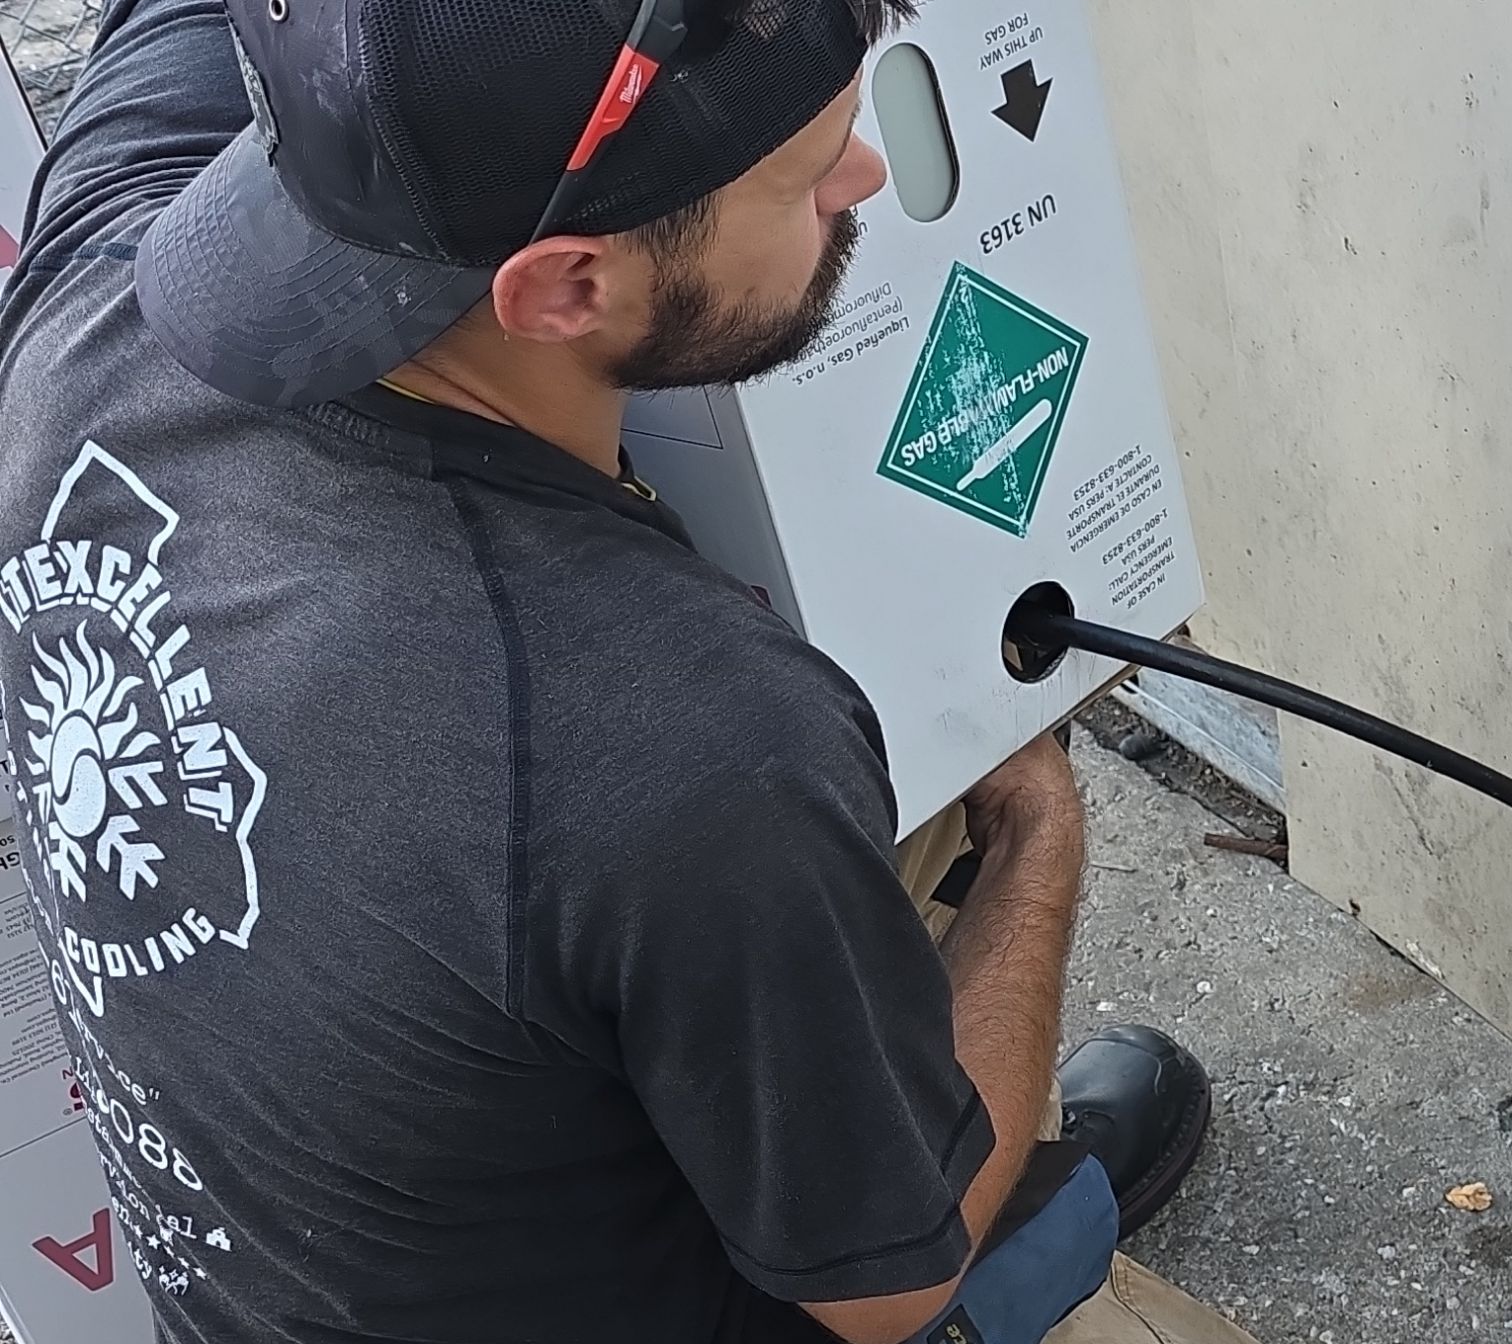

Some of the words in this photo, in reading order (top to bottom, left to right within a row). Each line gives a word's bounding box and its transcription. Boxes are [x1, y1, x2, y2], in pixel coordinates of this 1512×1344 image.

[1008, 13, 1028, 32] FOR
[985, 25, 1006, 45] GAS
[1029, 27, 1043, 42] UP
[1005, 36, 1027, 56] THIS
[981, 49, 1003, 69] WAY
[1028, 195, 1055, 226] UN
[980, 213, 1024, 254] 3163
[856, 317, 909, 355] Liquefied
[828, 348, 853, 365] Gas,
[792, 363, 825, 385] n.o.s.
[896, 429, 940, 467] GAS
[1074, 445, 1140, 500] 1-800-633-8253
[1115, 455, 1151, 487] CONTACTE
[1125, 465, 1159, 496] DURANTE
[1105, 482, 1113, 492] A:
[1152, 479, 1161, 492] EN
[1086, 490, 1104, 509] PERS
[1116, 491, 1125, 502] EL
[1132, 488, 1150, 507] CASO
[1067, 499, 1115, 540] TRANSPORTE
[1069, 505, 1085, 520] USA
[1120, 503, 1130, 516] DE
[1071, 512, 1119, 552] EMERGENCIA
[1103, 508, 1167, 564] 1-800-633-8253
[1138, 535, 1154, 553] PERS
[1121, 550, 1137, 565] USA
[1131, 537, 1172, 576] EMERGENCY
[1109, 572, 1128, 590] CALL:
[1112, 551, 1174, 605] TRANSPORTATION
[1157, 573, 1165, 585] IN
[1138, 581, 1155, 600] CASE
[1128, 596, 1137, 609] OF
[63, 907, 216, 980] COOLING
